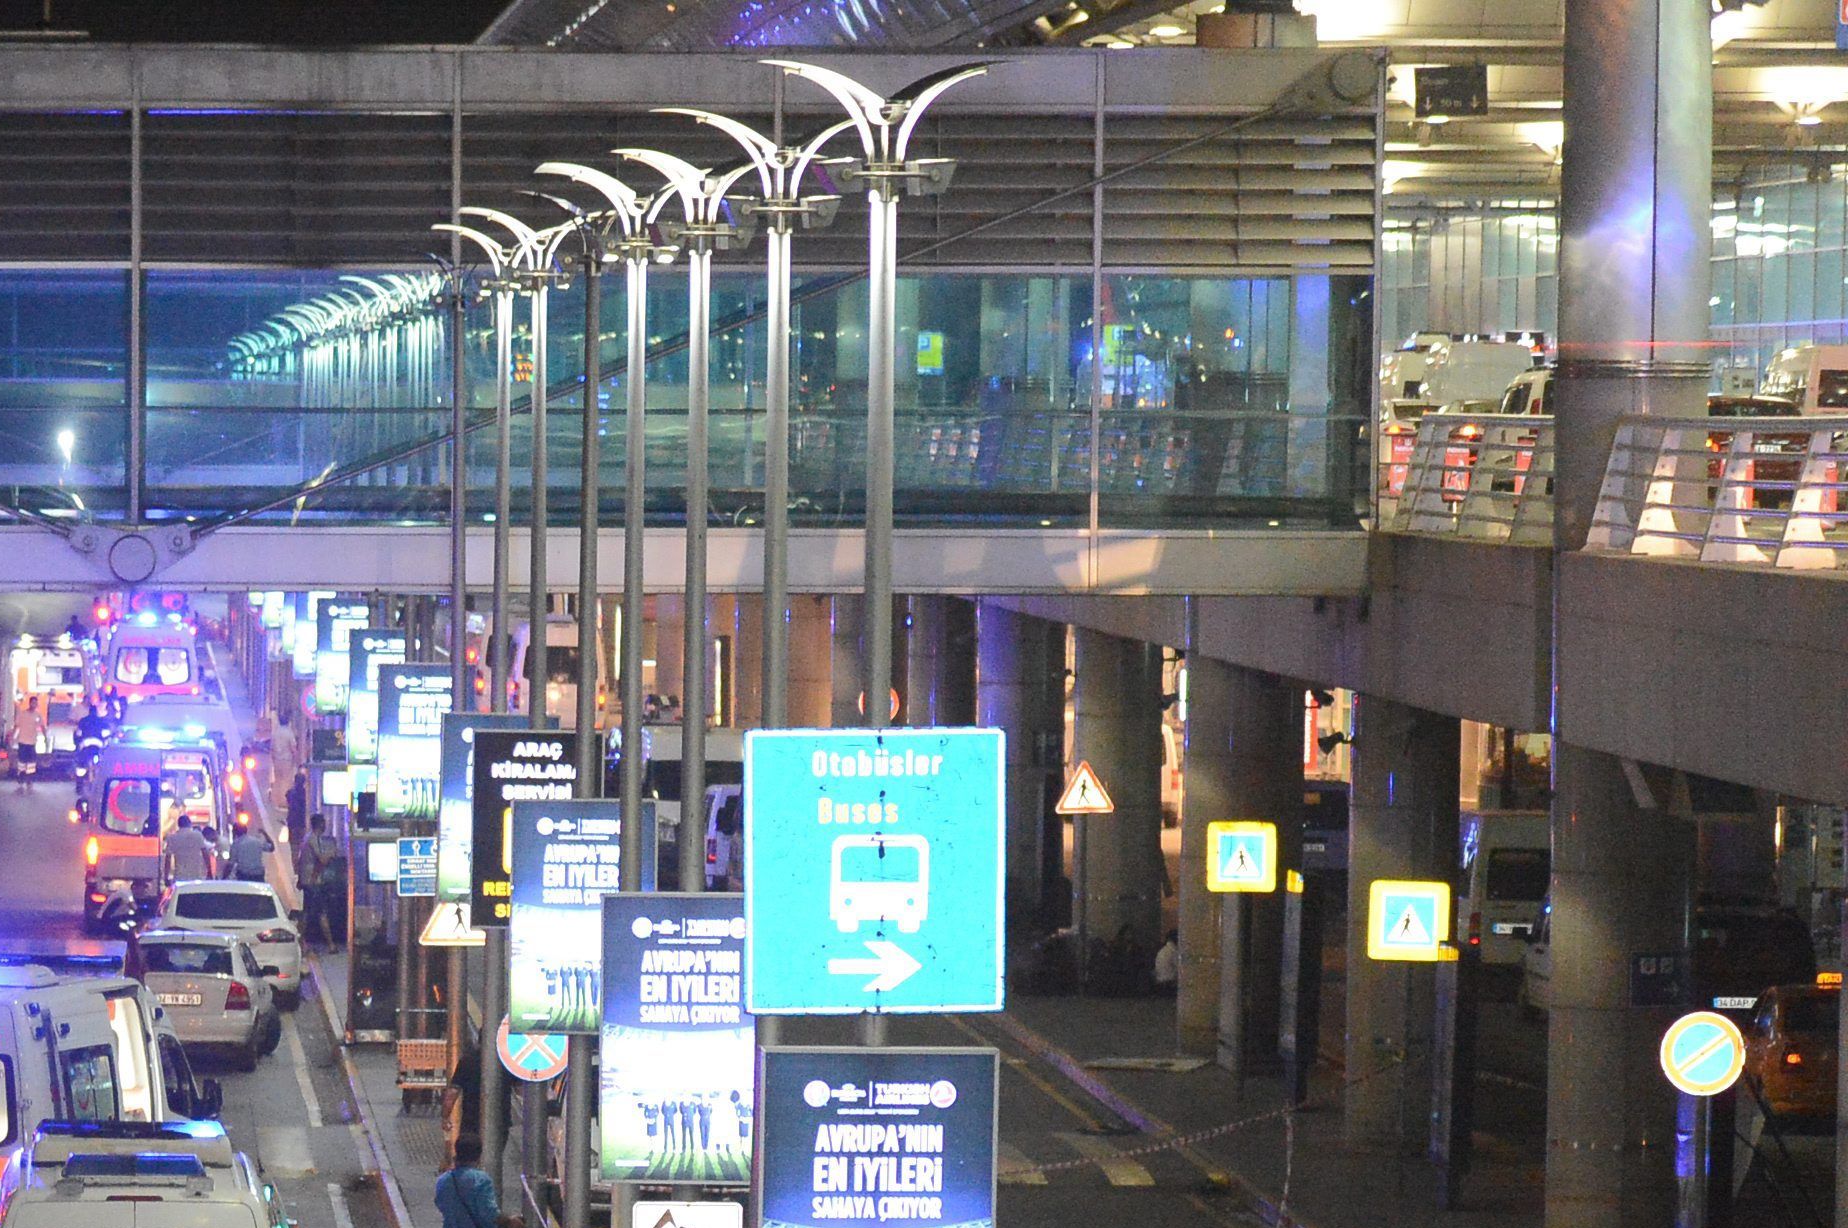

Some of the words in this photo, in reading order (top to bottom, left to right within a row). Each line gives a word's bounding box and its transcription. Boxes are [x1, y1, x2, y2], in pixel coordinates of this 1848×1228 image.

[513, 741, 563, 761] ARAÇ
[812, 749, 944, 777] Otobüsler
[818, 797, 899, 824] Buses
[640, 975, 668, 1003] EN
[815, 1124, 944, 1152] AVRUPA'NIN
[813, 1157, 848, 1192] EN
[853, 1157, 943, 1192] İYİLERİ
[812, 1196, 876, 1219] SAHAYA
[878, 1196, 942, 1222] ÇIKIYOR
